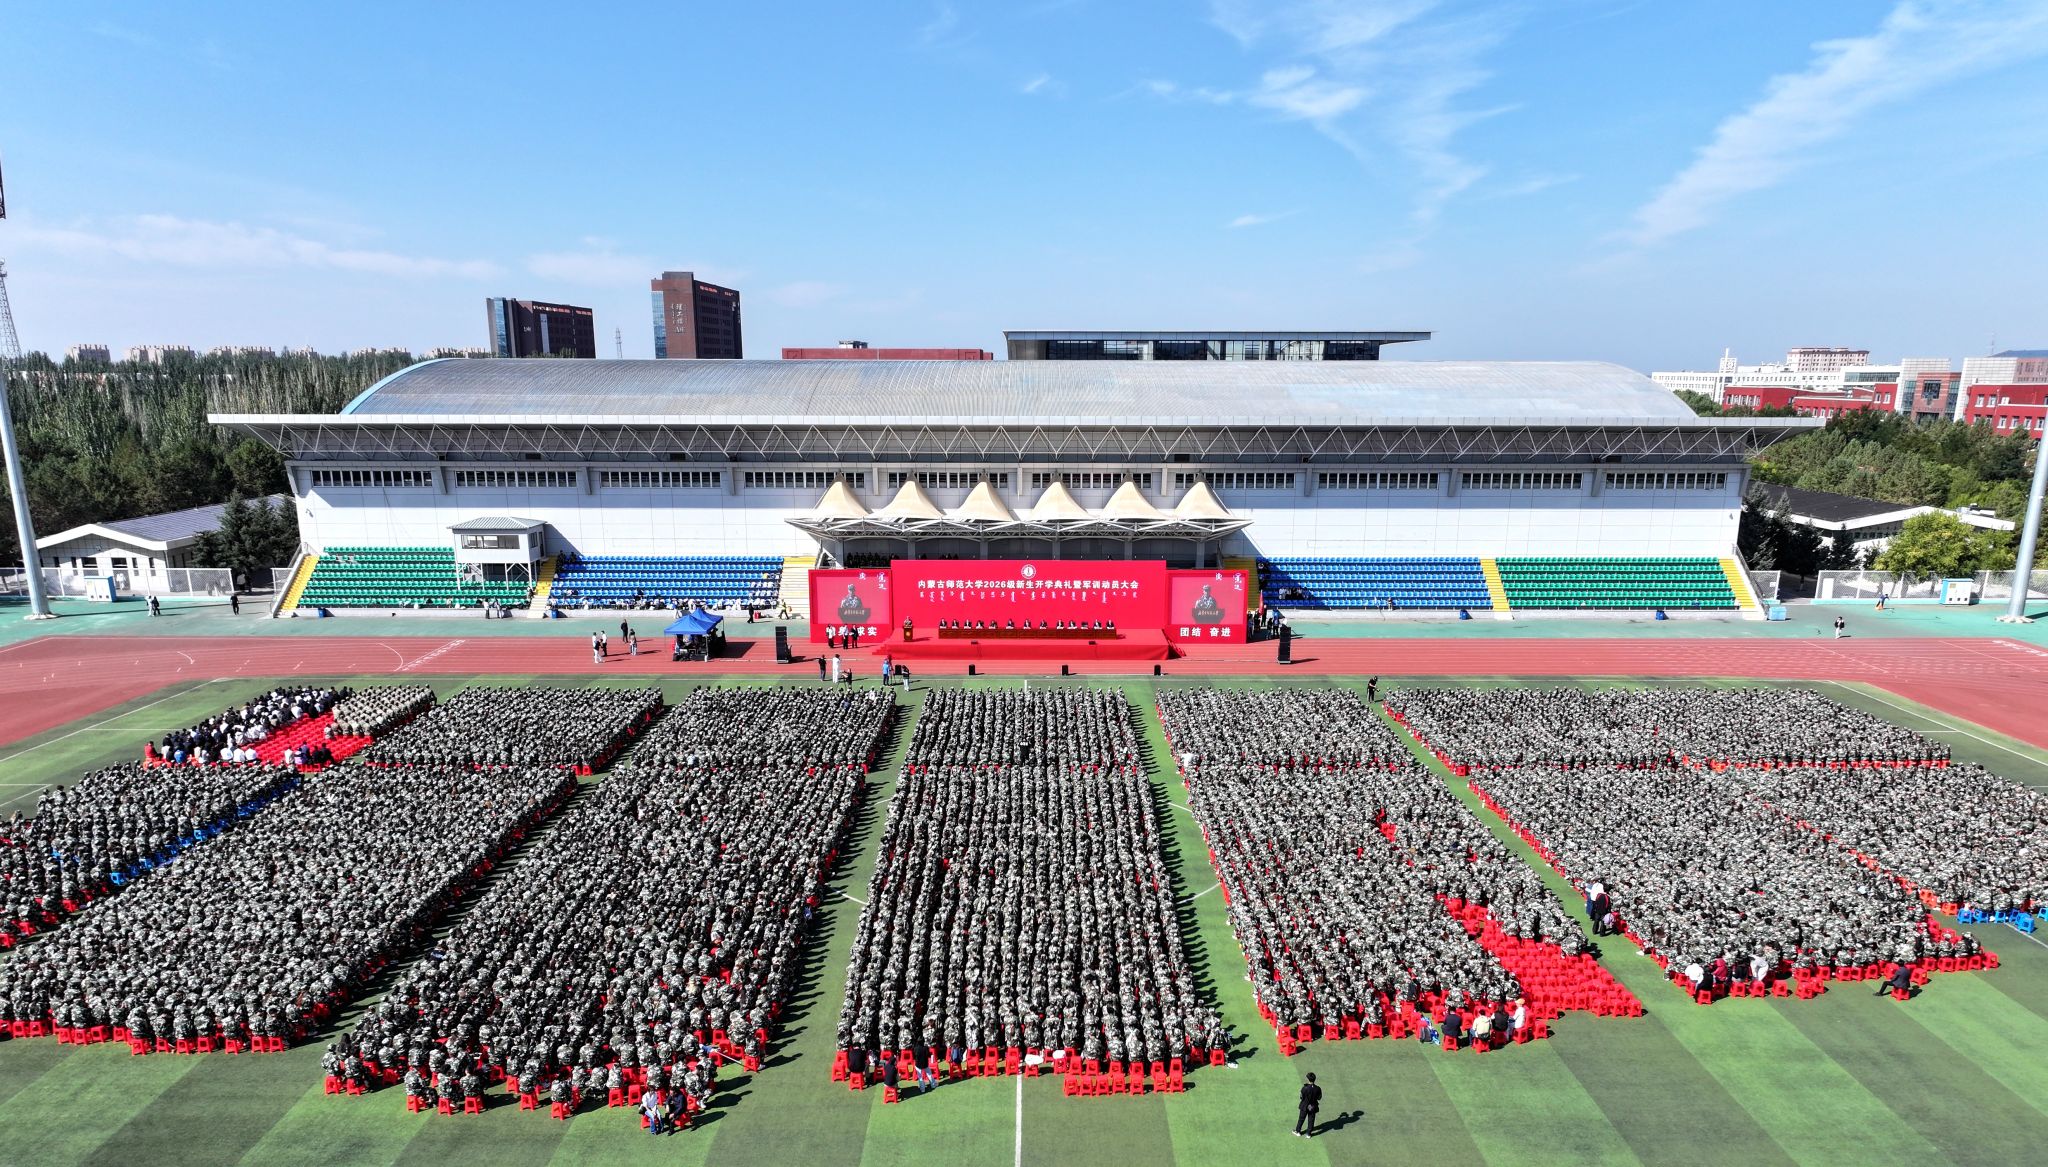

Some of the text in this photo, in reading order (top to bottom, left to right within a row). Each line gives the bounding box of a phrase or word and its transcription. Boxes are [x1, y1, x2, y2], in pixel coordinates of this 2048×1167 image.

[918, 579, 1139, 589] 内蒙古师范大学2026级新生开学典礼暨军训动员大会
[1180, 627, 1231, 637] 团结 奋进
